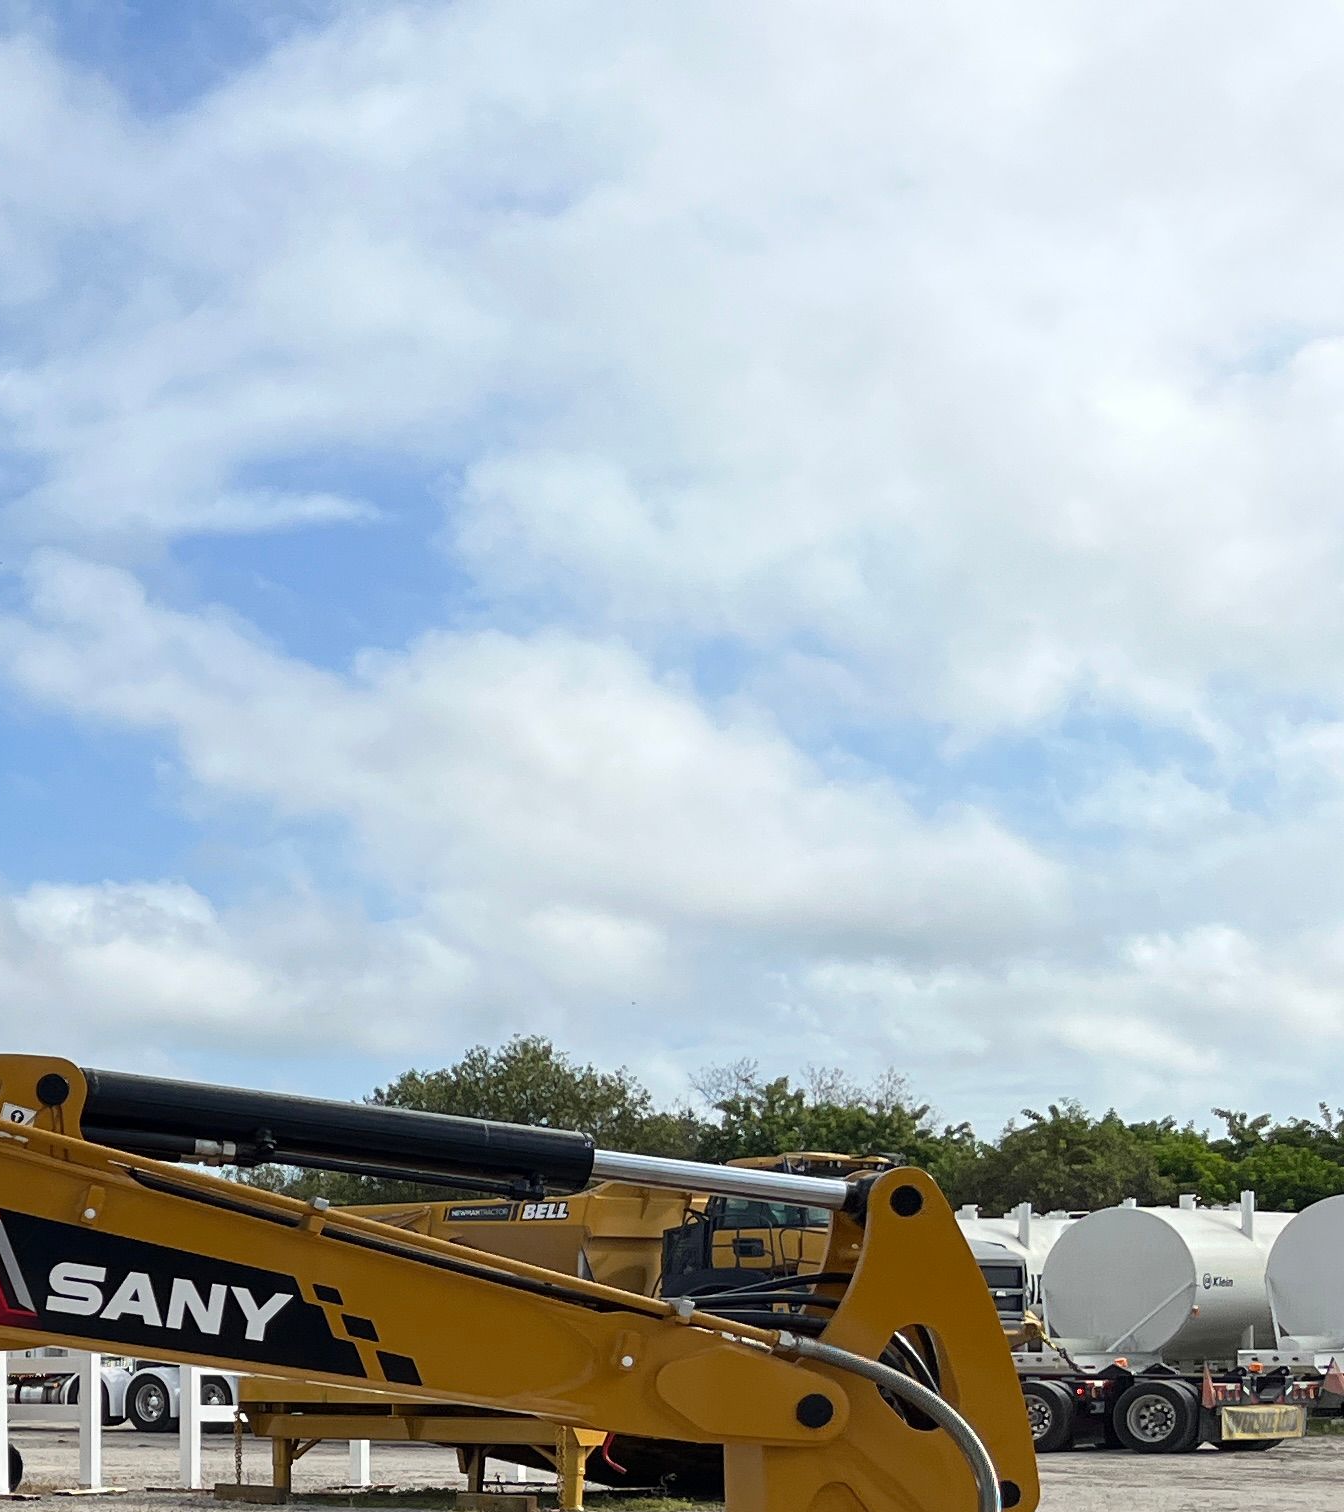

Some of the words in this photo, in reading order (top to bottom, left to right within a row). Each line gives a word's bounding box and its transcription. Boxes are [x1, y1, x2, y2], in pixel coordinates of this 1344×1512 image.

[522, 1202, 568, 1220] BELL
[1213, 1276, 1233, 1287] Klein
[45, 1261, 294, 1342] SANY
